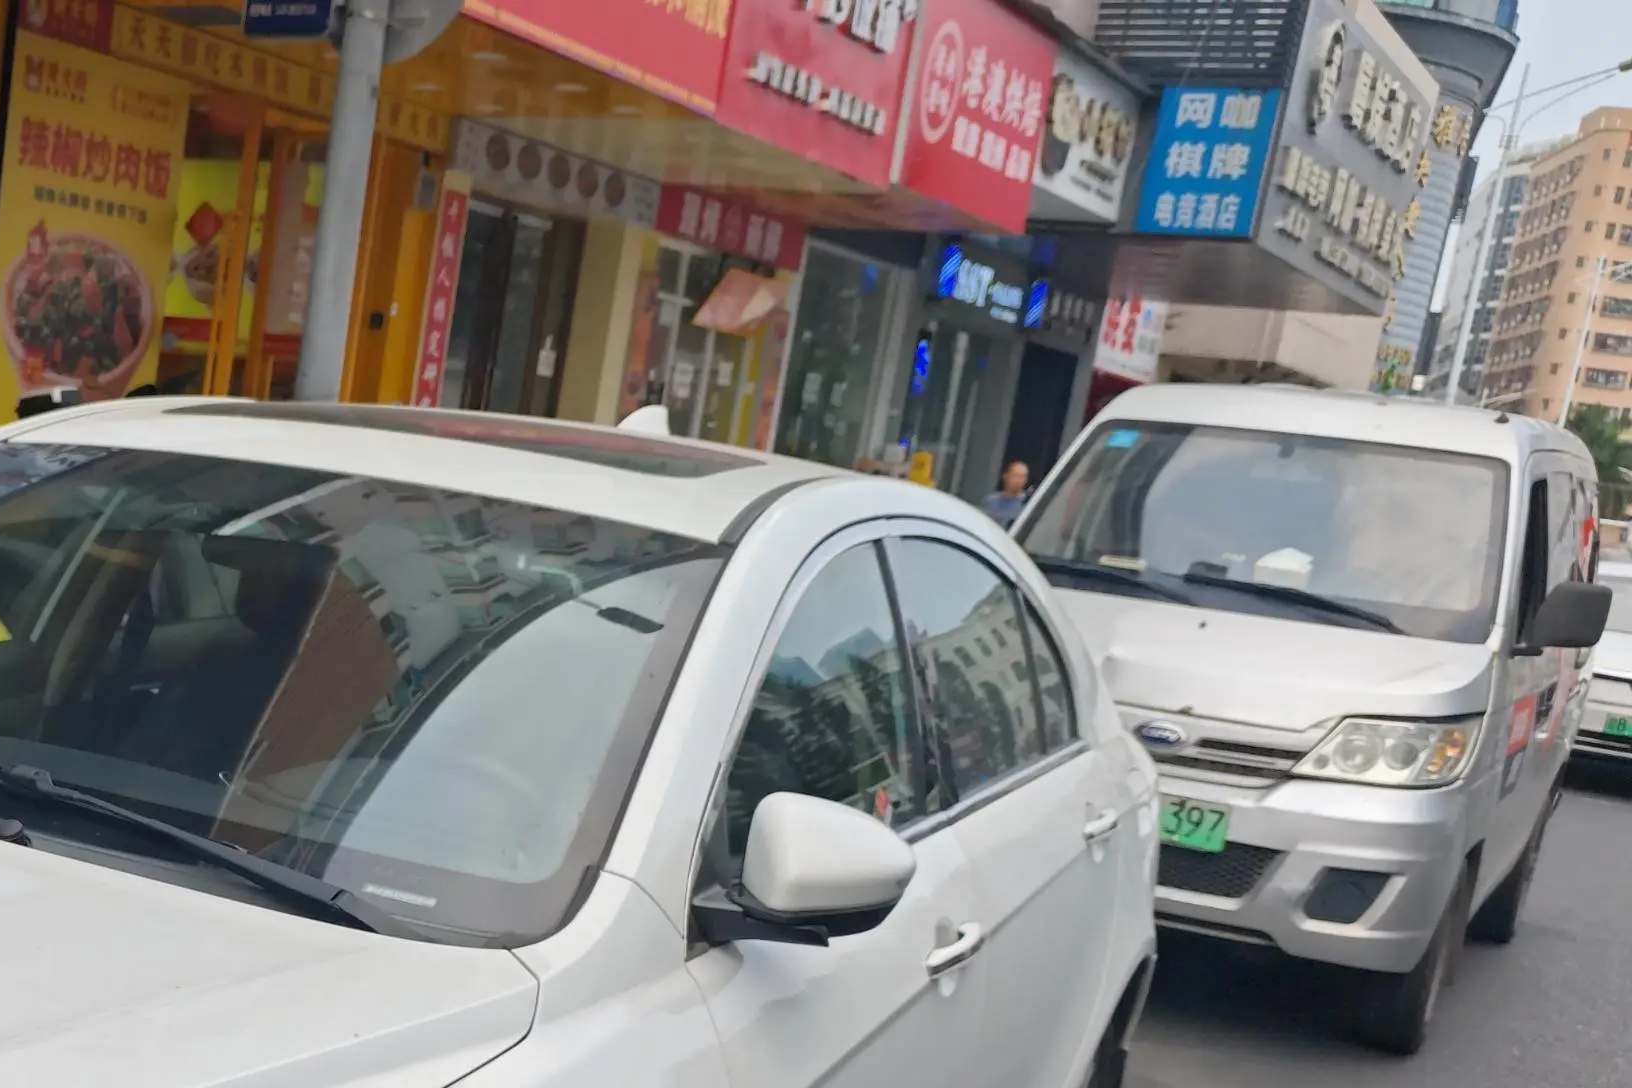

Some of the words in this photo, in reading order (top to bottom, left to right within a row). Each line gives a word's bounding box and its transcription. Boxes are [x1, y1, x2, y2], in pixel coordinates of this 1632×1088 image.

[1174, 92, 1263, 129] 网咖
[19, 114, 172, 200] 辣椒炒肉饭
[1165, 140, 1252, 181] 棋牌
[1153, 189, 1241, 231] 电竞酒店
[1160, 799, 1226, 842] 397
